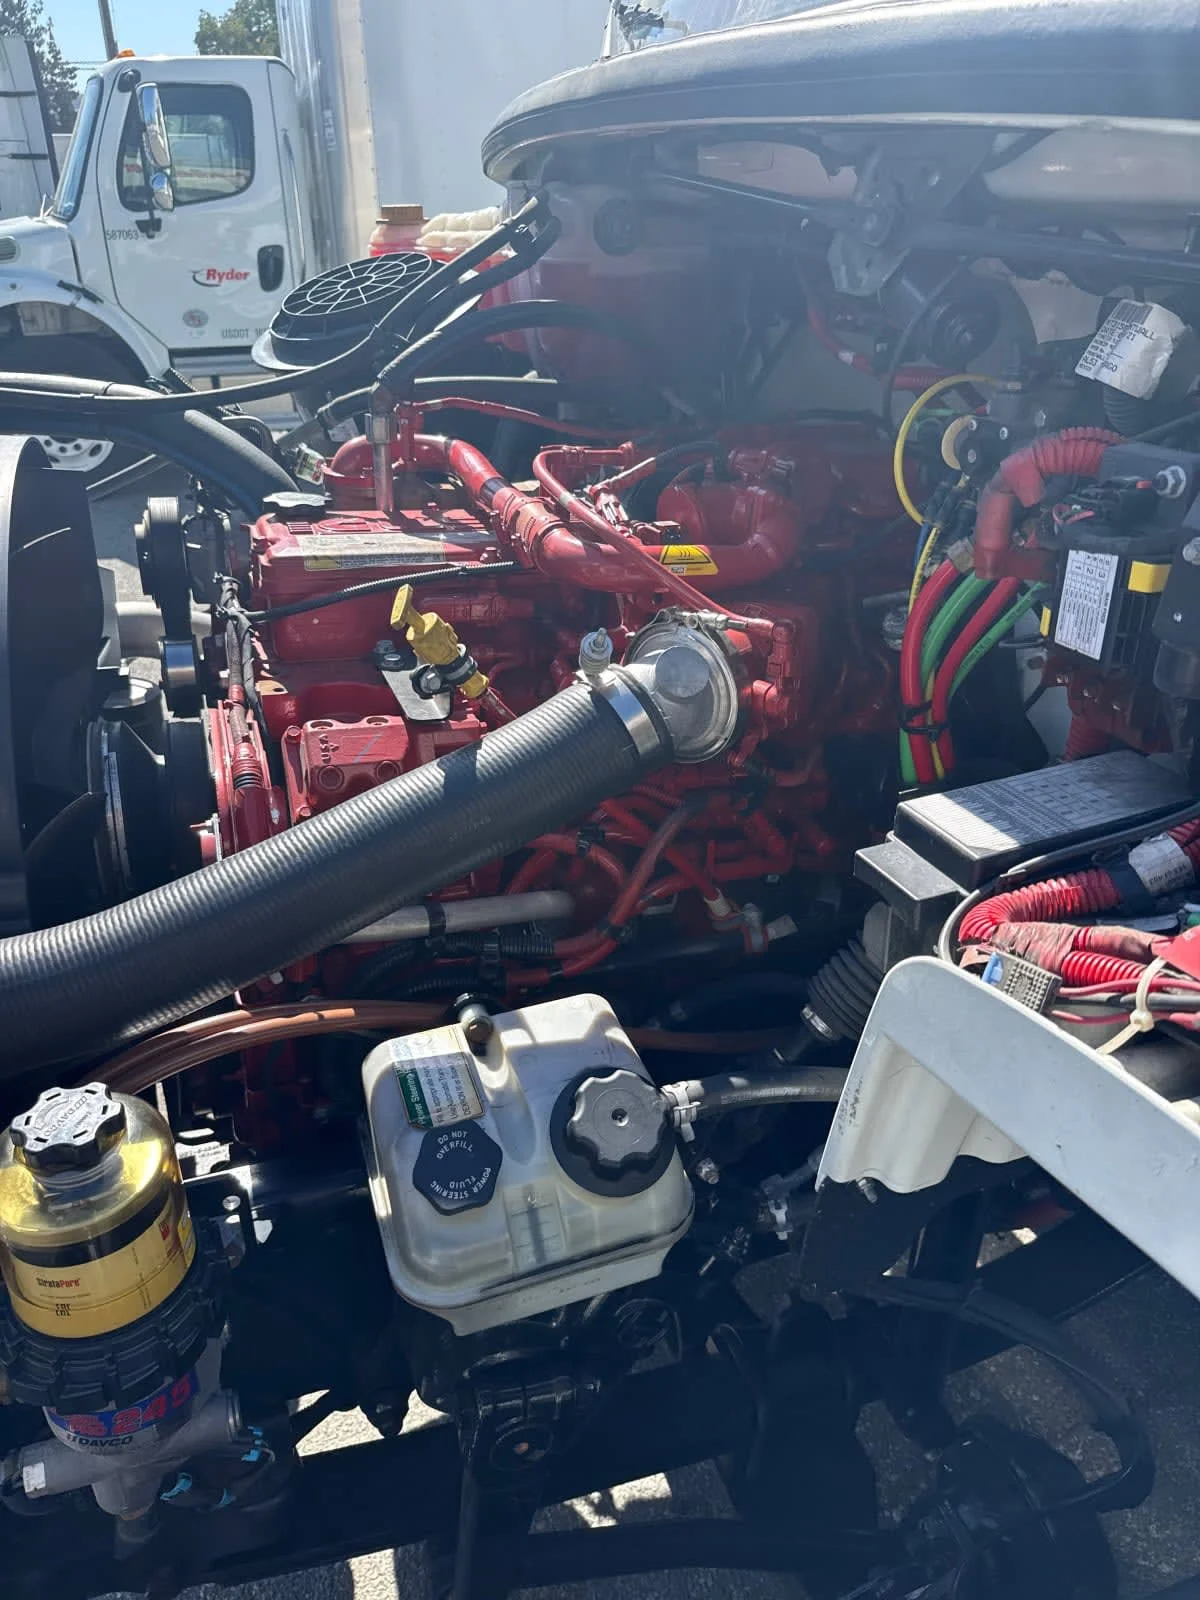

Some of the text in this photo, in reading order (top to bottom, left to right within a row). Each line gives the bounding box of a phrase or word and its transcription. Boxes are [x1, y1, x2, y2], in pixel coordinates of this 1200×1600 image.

[106, 229, 140, 241] 587063
[205, 267, 251, 284] Ryder
[437, 1130, 468, 1145] DO NOT
[436, 1140, 474, 1160] OVERFILL
[430, 1167, 492, 1200] POWER STEERING
[449, 1175, 477, 1189] FLUID
[79, 1435, 133, 1447] DAVCO
